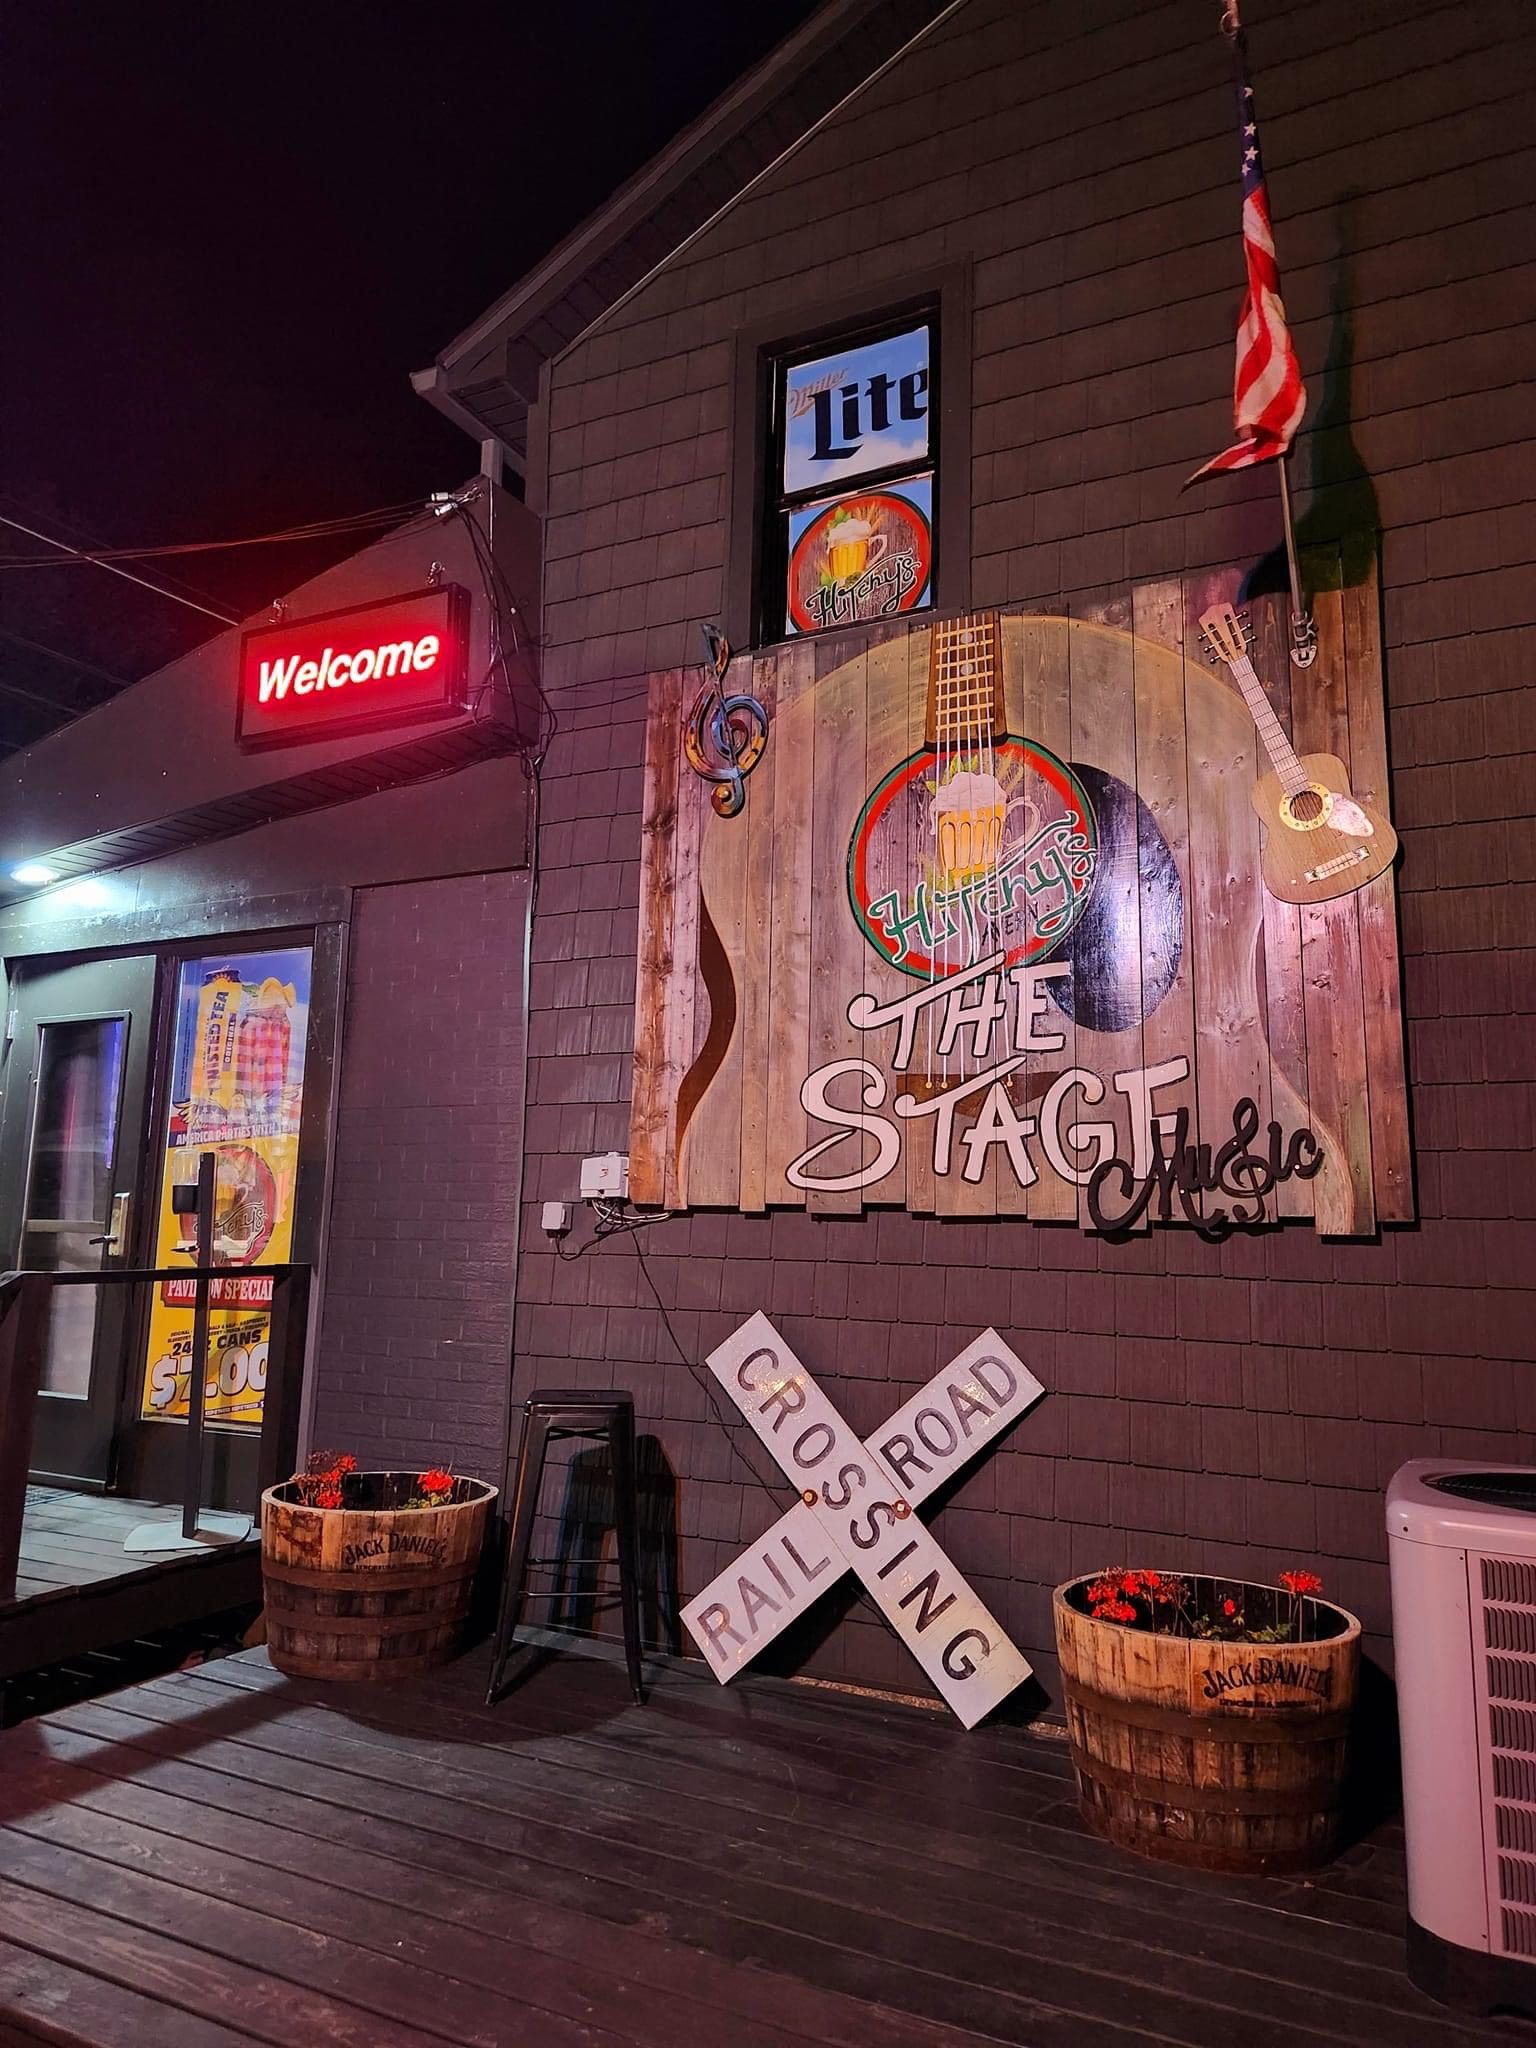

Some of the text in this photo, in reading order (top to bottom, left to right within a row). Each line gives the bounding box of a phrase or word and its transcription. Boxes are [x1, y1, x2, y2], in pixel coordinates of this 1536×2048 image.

[807, 367, 928, 461] Lite
[257, 634, 440, 703] Welcome
[210, 991, 229, 1020] TEA
[848, 952, 1072, 1069] THE
[176, 1129, 213, 1146] AMERICA
[785, 1055, 1188, 1191] STAGE
[217, 1329, 262, 1349] CANS
[879, 1355, 1018, 1491] ROAD
[344, 1537, 385, 1565] JACK
[737, 1347, 991, 1681] CROSSING
[697, 1535, 831, 1662] RAIL
[1201, 1662, 1255, 1699] JACK
